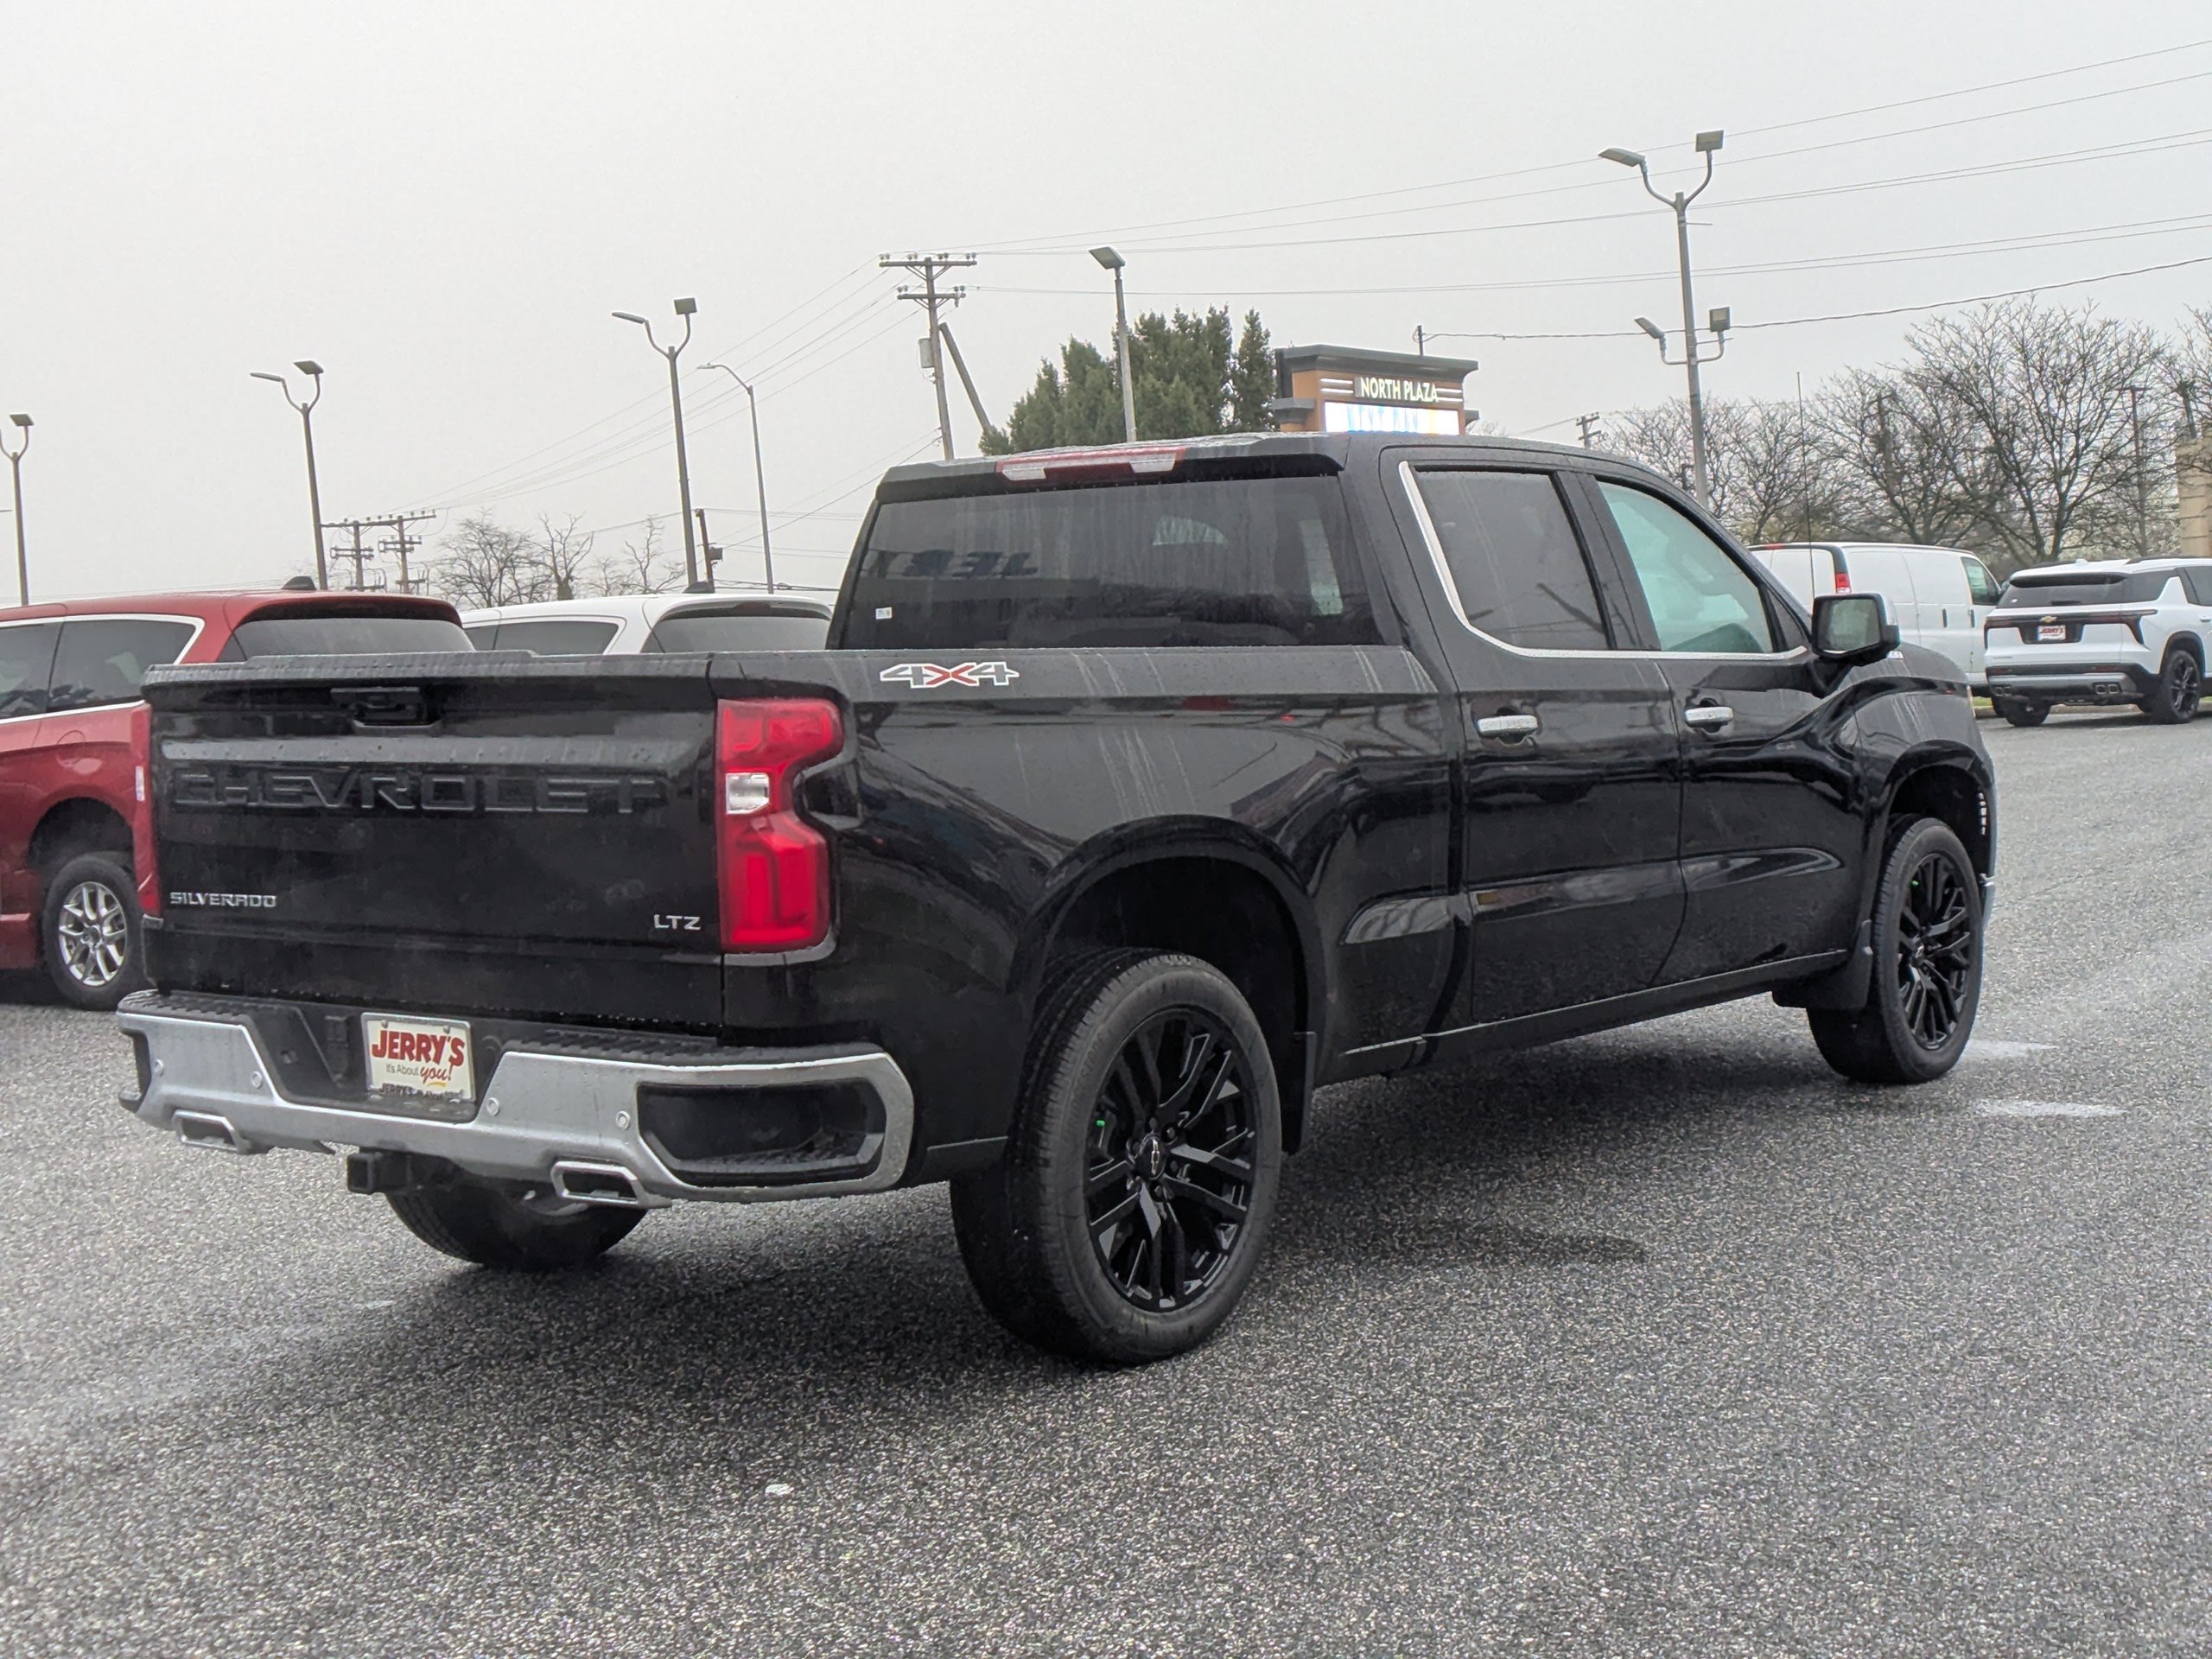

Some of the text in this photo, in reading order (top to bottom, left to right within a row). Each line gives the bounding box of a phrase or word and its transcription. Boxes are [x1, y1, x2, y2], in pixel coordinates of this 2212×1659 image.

[1360, 376, 1439, 403] NORTH PLAZA
[173, 768, 661, 813] CHEVROLET
[169, 892, 276, 908] SILVERADO
[653, 913, 702, 931] LTZ
[372, 1030, 465, 1067] JERRY'S
[397, 1064, 419, 1077] About
